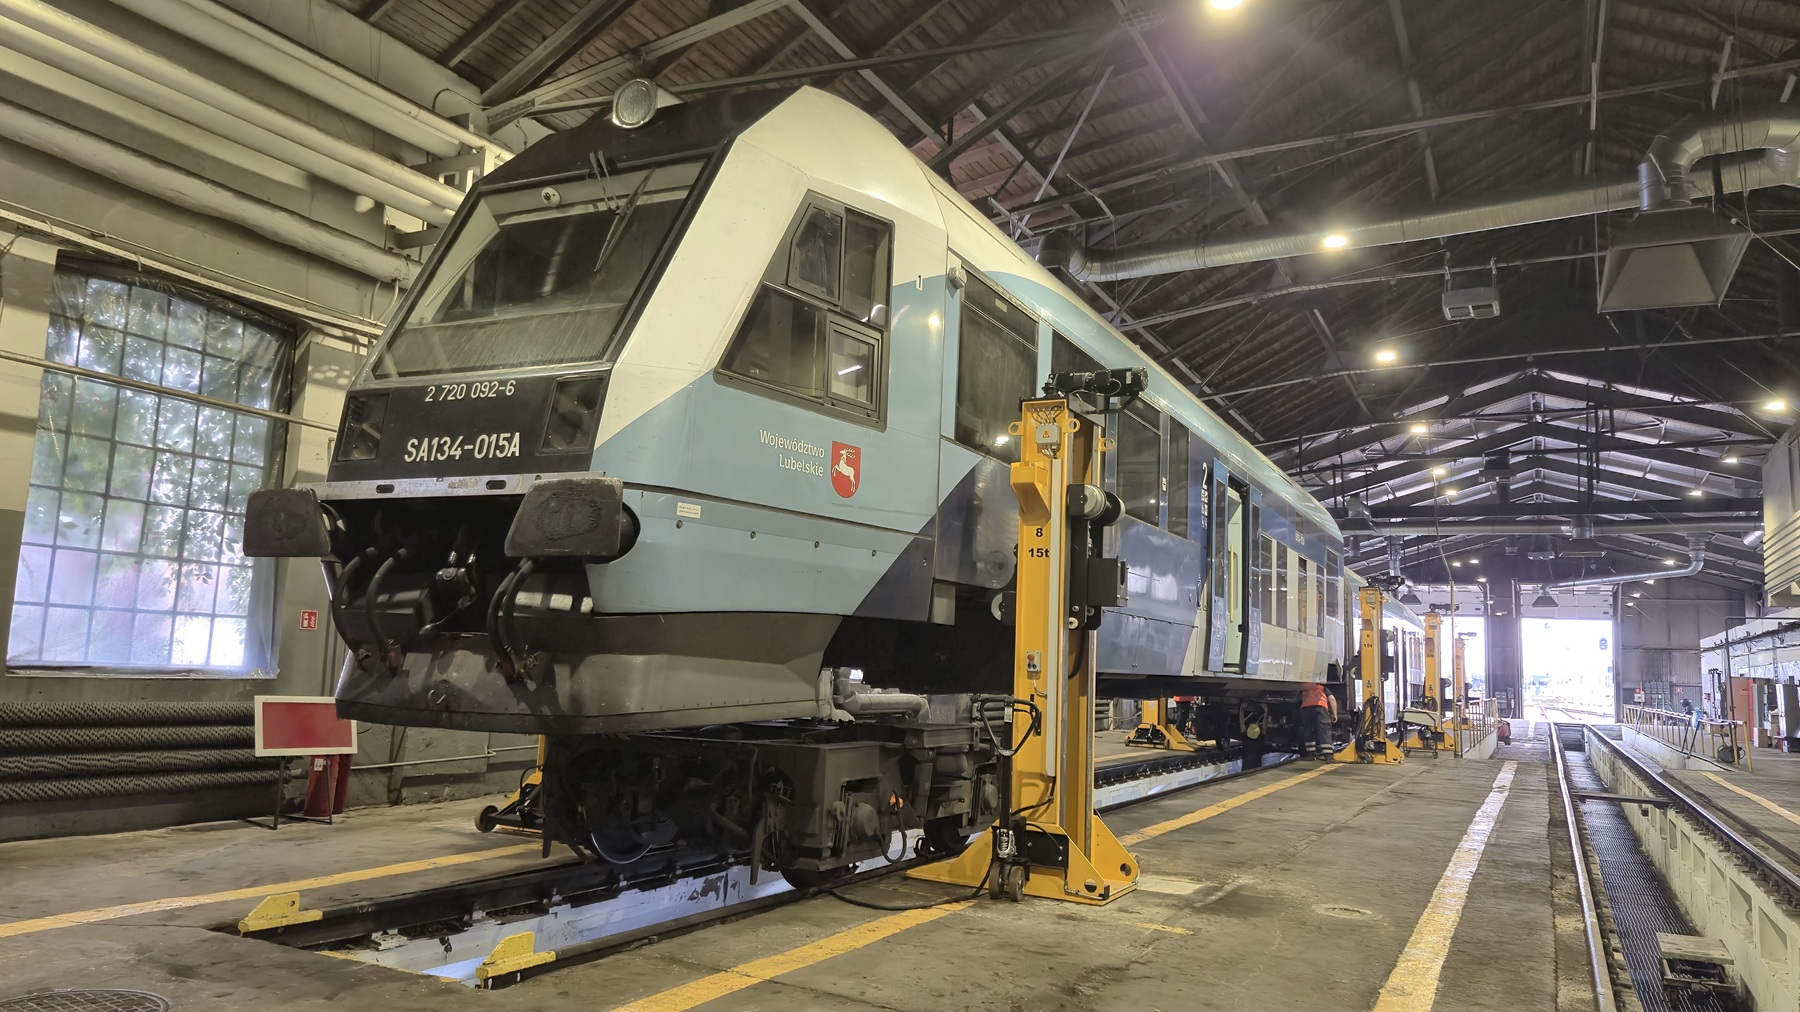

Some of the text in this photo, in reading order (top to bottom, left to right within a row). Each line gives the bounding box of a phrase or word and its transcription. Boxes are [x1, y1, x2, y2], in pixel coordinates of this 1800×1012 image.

[425, 380, 517, 402] 2 720 092-6
[404, 432, 520, 462] SA134-015A
[759, 429, 825, 458] Województwo
[779, 454, 824, 477] Lubelskie
[1202, 461, 1208, 490] 2
[1035, 527, 1044, 538] 8
[1028, 547, 1050, 558] 15t
